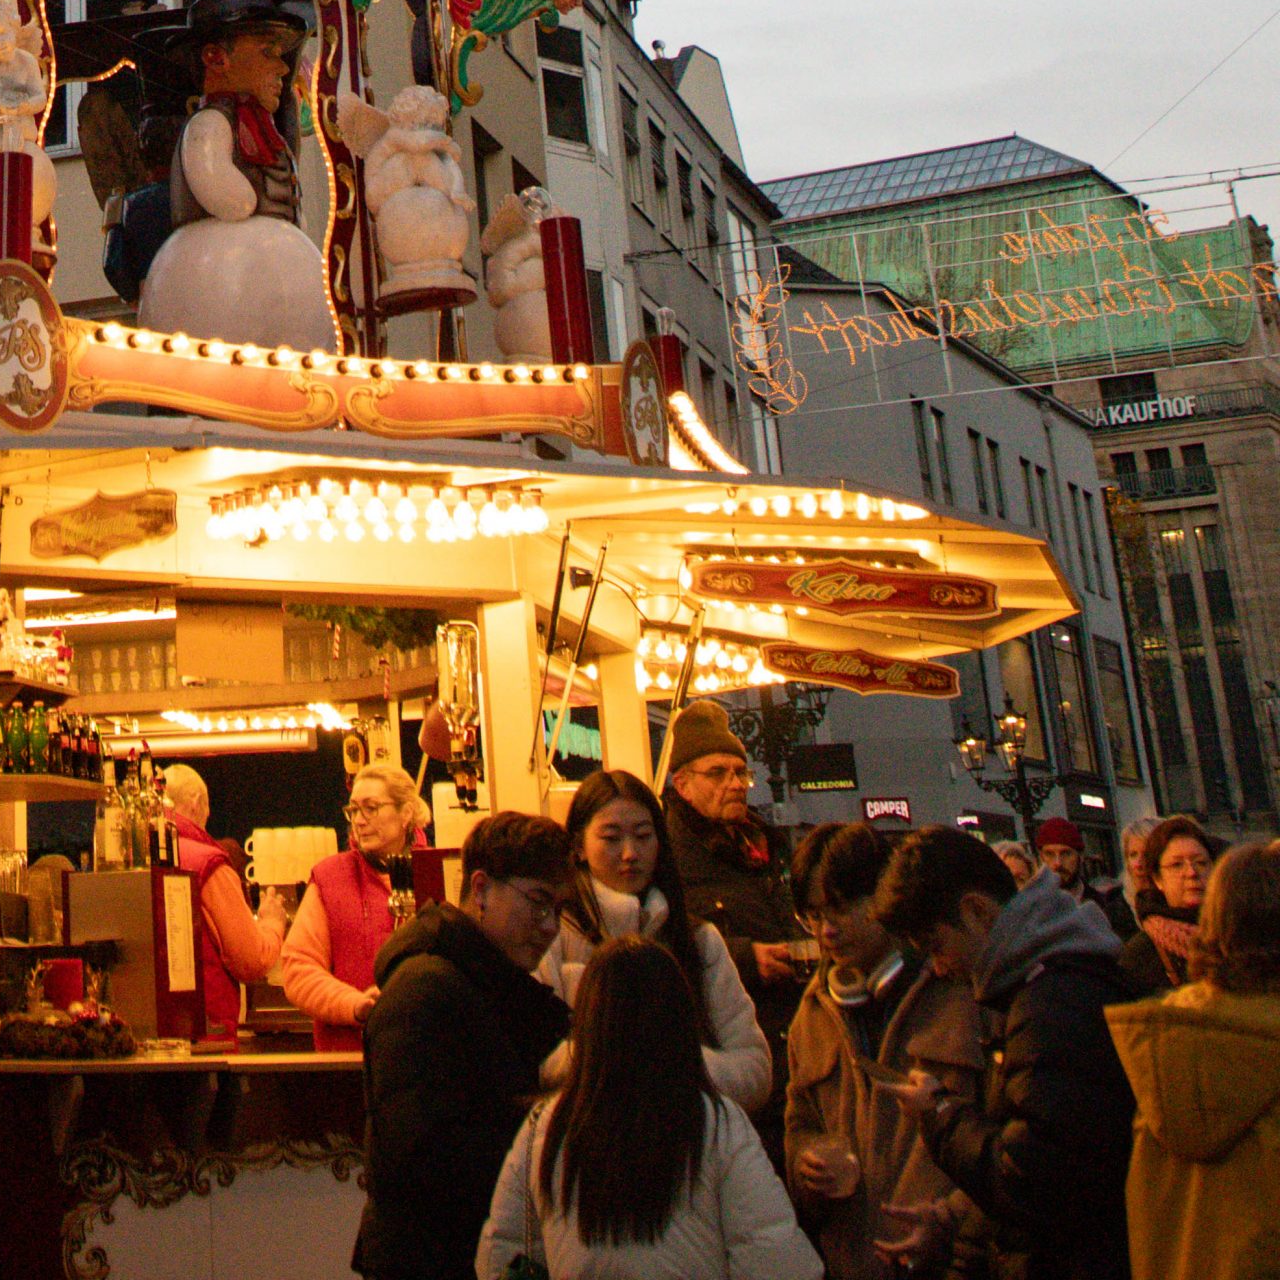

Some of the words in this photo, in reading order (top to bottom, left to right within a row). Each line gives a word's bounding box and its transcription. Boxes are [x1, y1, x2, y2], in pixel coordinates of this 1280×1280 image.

[787, 570, 897, 605] Kakao
[799, 779, 856, 790] CALZEDONIA
[866, 800, 910, 819] CAMPER
